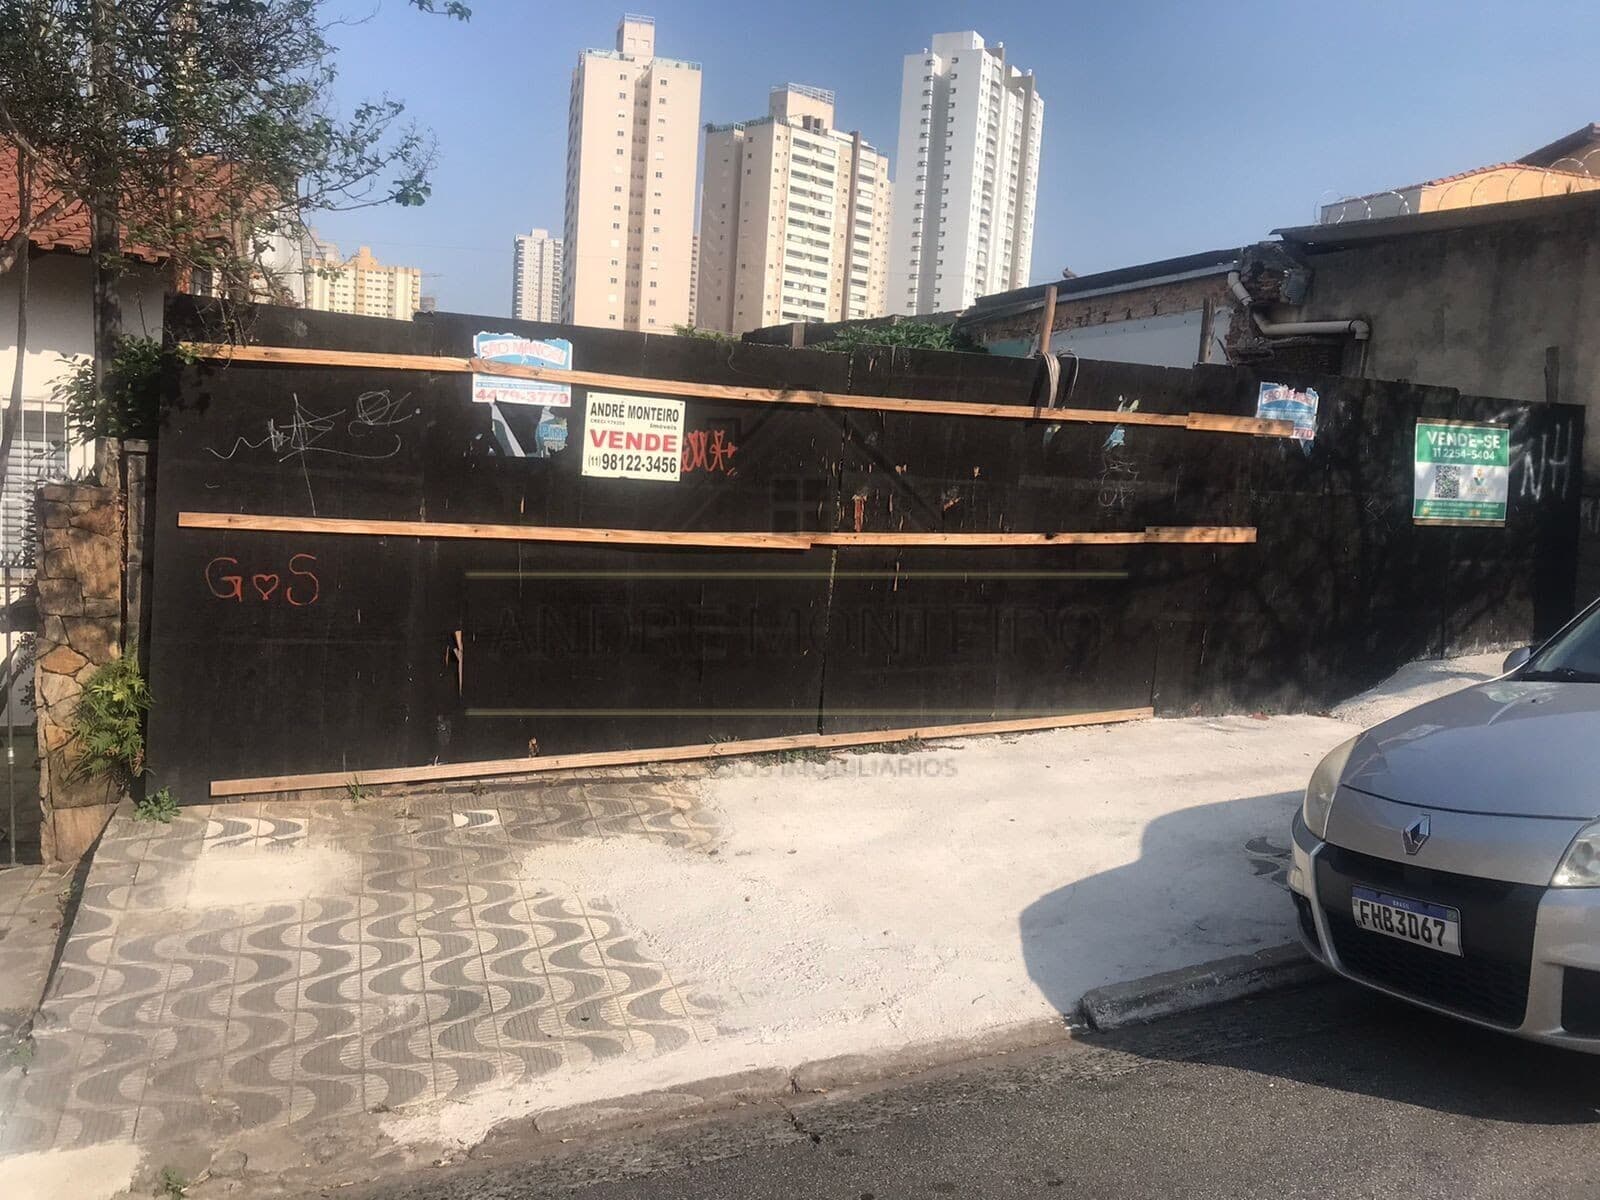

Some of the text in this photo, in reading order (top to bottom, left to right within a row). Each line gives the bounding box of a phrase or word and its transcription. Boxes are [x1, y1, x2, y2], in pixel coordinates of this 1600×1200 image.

[590, 401, 679, 423] ANDRÉ MONTEIRO
[590, 429, 678, 453] VENDE
[1427, 431, 1501, 449] VENDE-SE
[588, 453, 677, 473] (11) 98122-3456
[1432, 447, 1495, 460] 11 2254-5404
[1360, 900, 1446, 947] FHB3D67
